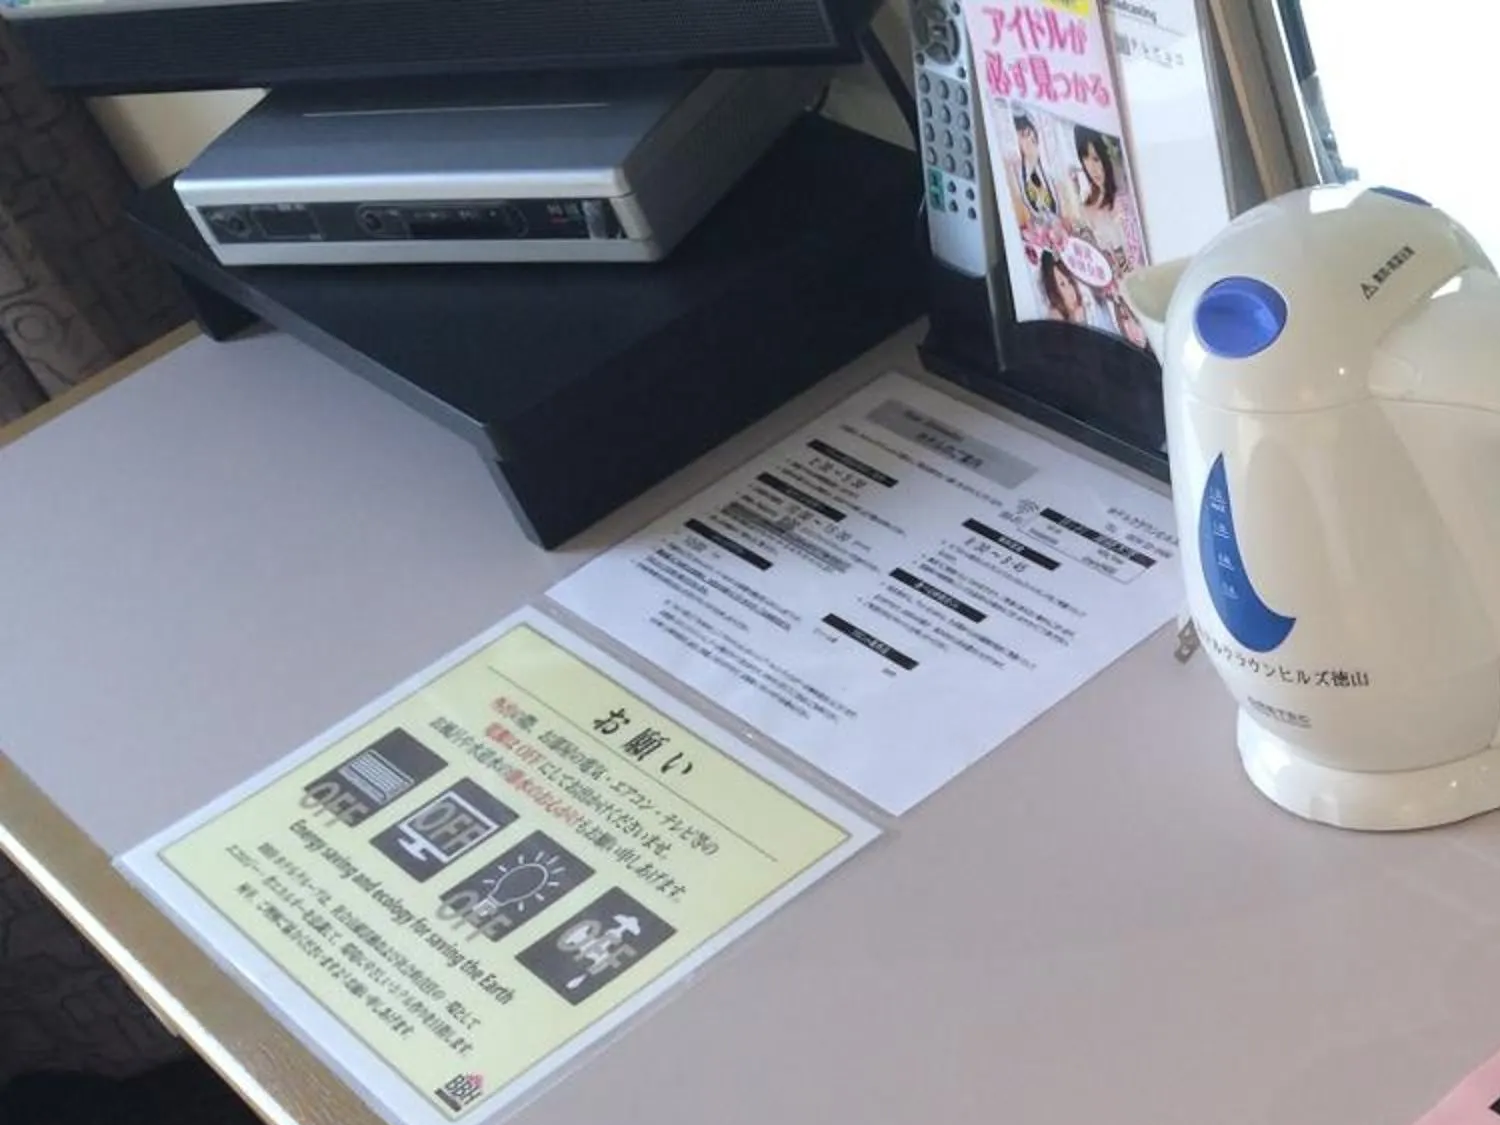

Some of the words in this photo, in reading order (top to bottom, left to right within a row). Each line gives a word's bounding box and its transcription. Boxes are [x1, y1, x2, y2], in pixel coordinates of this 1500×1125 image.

[982, 7, 1089, 53] アイドルが
[986, 55, 1111, 107] 必ず見つかる
[587, 704, 705, 784] お願い
[293, 777, 371, 833] OFF
[283, 817, 332, 854] Energy
[410, 799, 489, 856] OFF
[314, 843, 364, 881] saving
[350, 869, 382, 893] and
[365, 885, 420, 927] ecology
[407, 916, 436, 938] for
[418, 929, 469, 969] saving
[457, 957, 488, 982] the
[475, 972, 518, 1006] Earth
[441, 1074, 482, 1107] BBH
